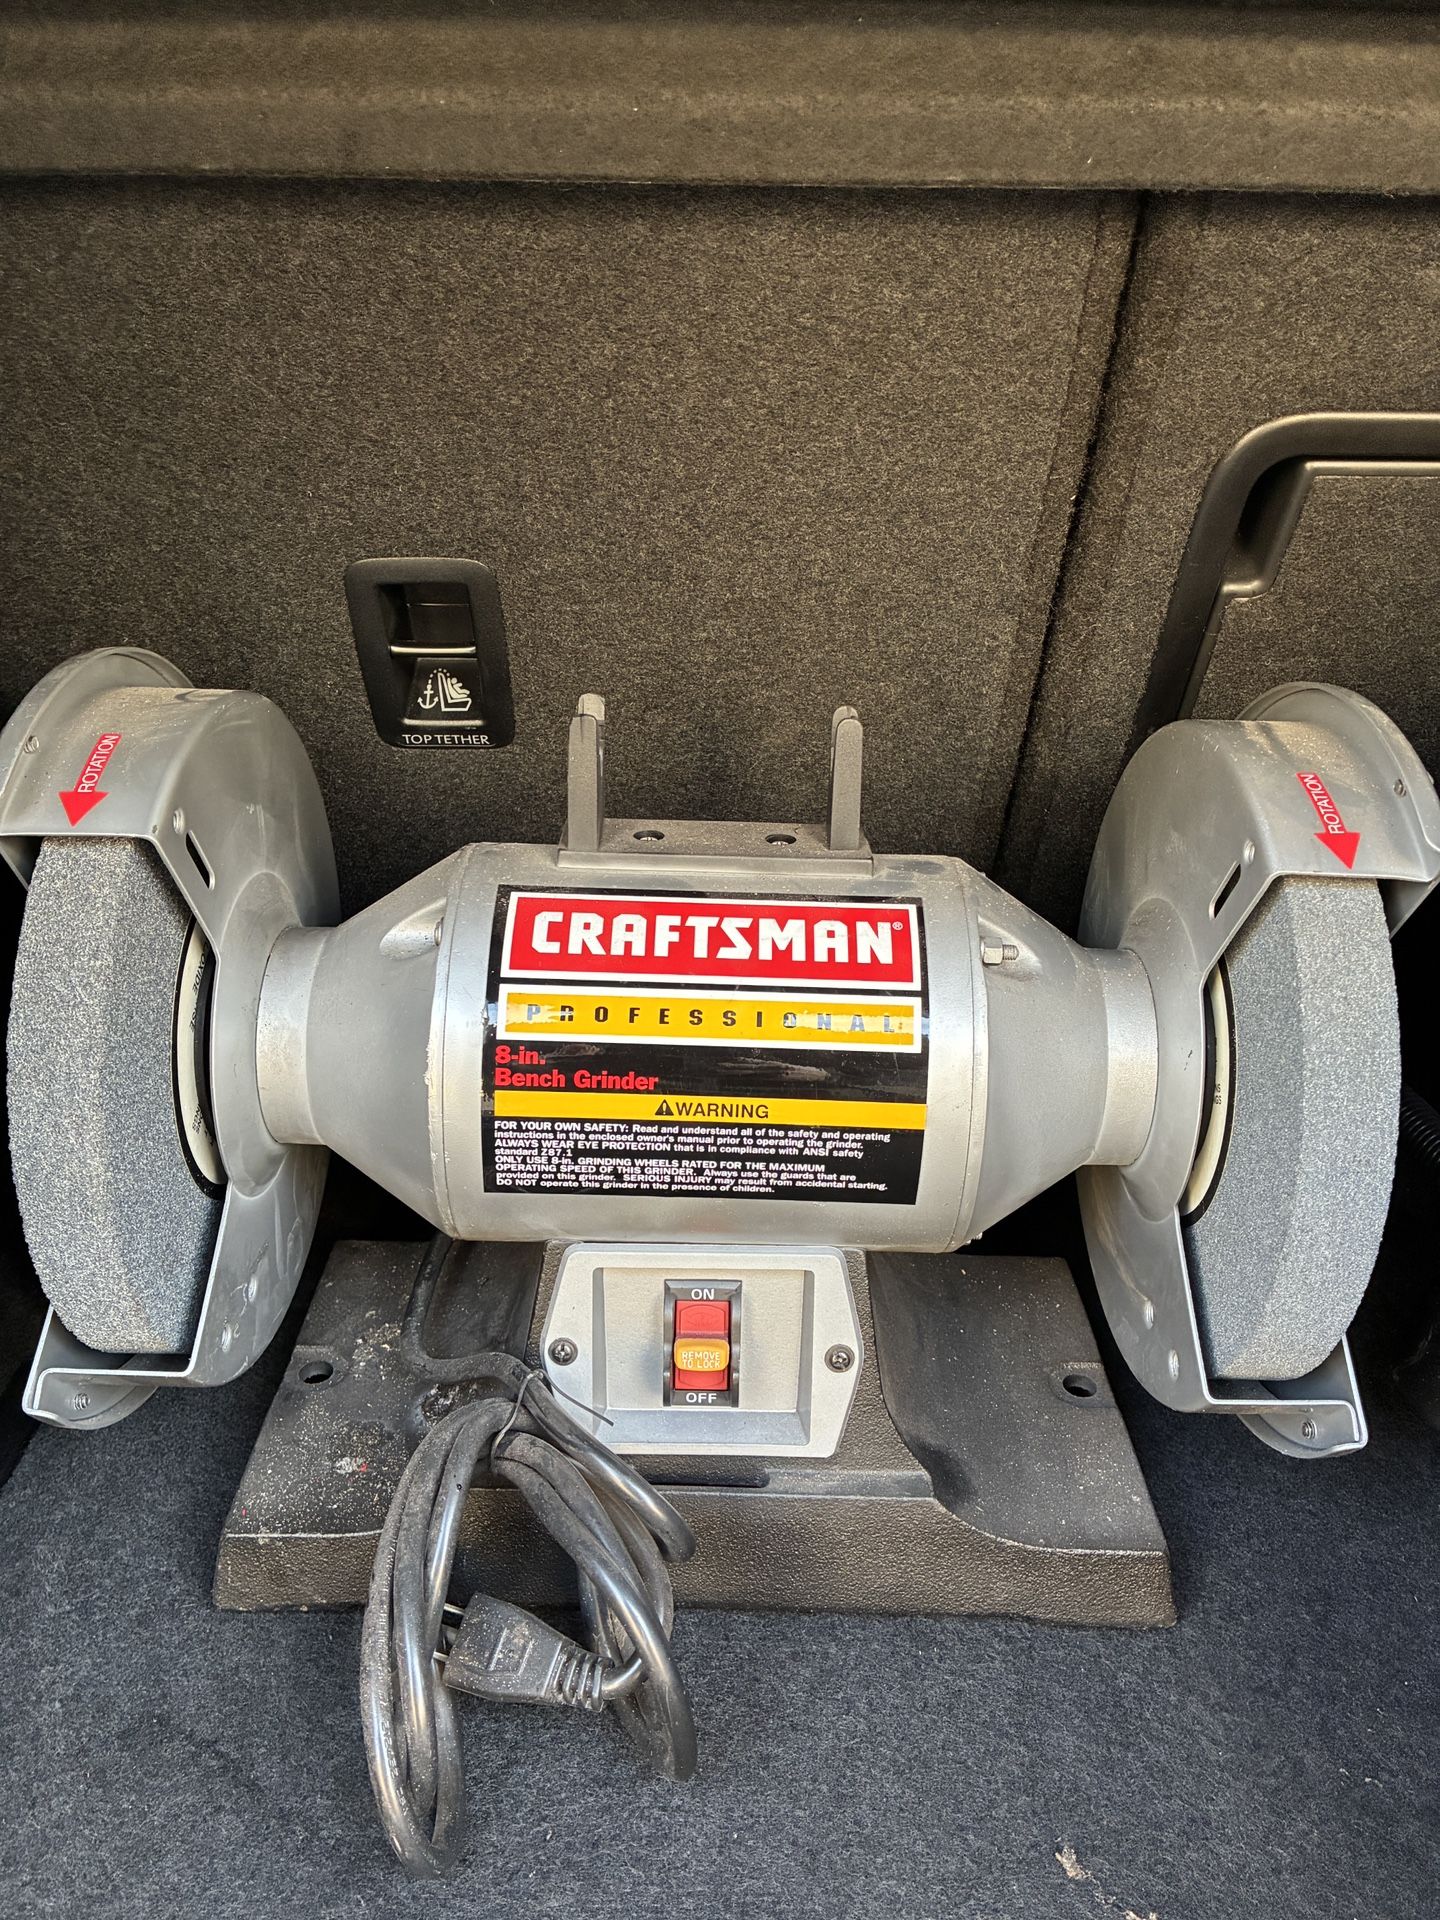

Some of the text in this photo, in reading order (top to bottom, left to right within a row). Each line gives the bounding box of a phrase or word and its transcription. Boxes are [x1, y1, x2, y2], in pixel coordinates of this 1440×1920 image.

[402, 734, 490, 745] TOP TETHER
[77, 734, 119, 793] ROTATION
[1299, 773, 1345, 834] ROTATION
[527, 1003, 894, 1032] PROFESSIONAL
[495, 1045, 546, 1065] 8-in.
[495, 1067, 659, 1090] Bench Grinder
[675, 1101, 769, 1120] WARNING
[494, 1121, 891, 1143] FOR YOUR OWN SAFETY: Read and understand all of the safety and operating
[494, 1130, 864, 1150] instructions in the enclosed owner's manual prior to operating the grinder.
[494, 1139, 864, 1159] ALWAYS WEAR EYE PROTECTION that is in compliance with ANSI safety
[494, 1147, 573, 1157] standard Z87.1
[495, 1155, 825, 1172] ONLY USE 8-in. GRINDING WHEELS RATED FOR THE MAXIMUM
[495, 1164, 557, 1172] OPERATING
[560, 1165, 596, 1173] SPEED
[617, 1166, 641, 1174] THIS
[644, 1167, 697, 1176] GRINDER.
[703, 1169, 738, 1178] Always
[761, 1170, 778, 1179] the
[780, 1172, 814, 1181] guards
[817, 1173, 837, 1181] that
[496, 1172, 539, 1181] provided
[578, 1174, 616, 1182] grinder.
[623, 1174, 671, 1183] SERIOUS
[674, 1176, 712, 1184] INJURY
[715, 1177, 735, 1186] may
[738, 1177, 767, 1186] result
[769, 1178, 793, 1187] from
[795, 1180, 846, 1189] accidental
[848, 1181, 888, 1191] starting.
[515, 1179, 538, 1187] NOT
[540, 1180, 579, 1188] operate
[602, 1181, 638, 1190] grinder
[671, 1184, 717, 1192] presence
[719, 1184, 731, 1192] of
[732, 1185, 775, 1193] children.
[691, 1288, 715, 1300] ON
[682, 1351, 720, 1361] REMOVE
[682, 1360, 720, 1369] TO LOCK
[685, 1392, 717, 1404] OFF
